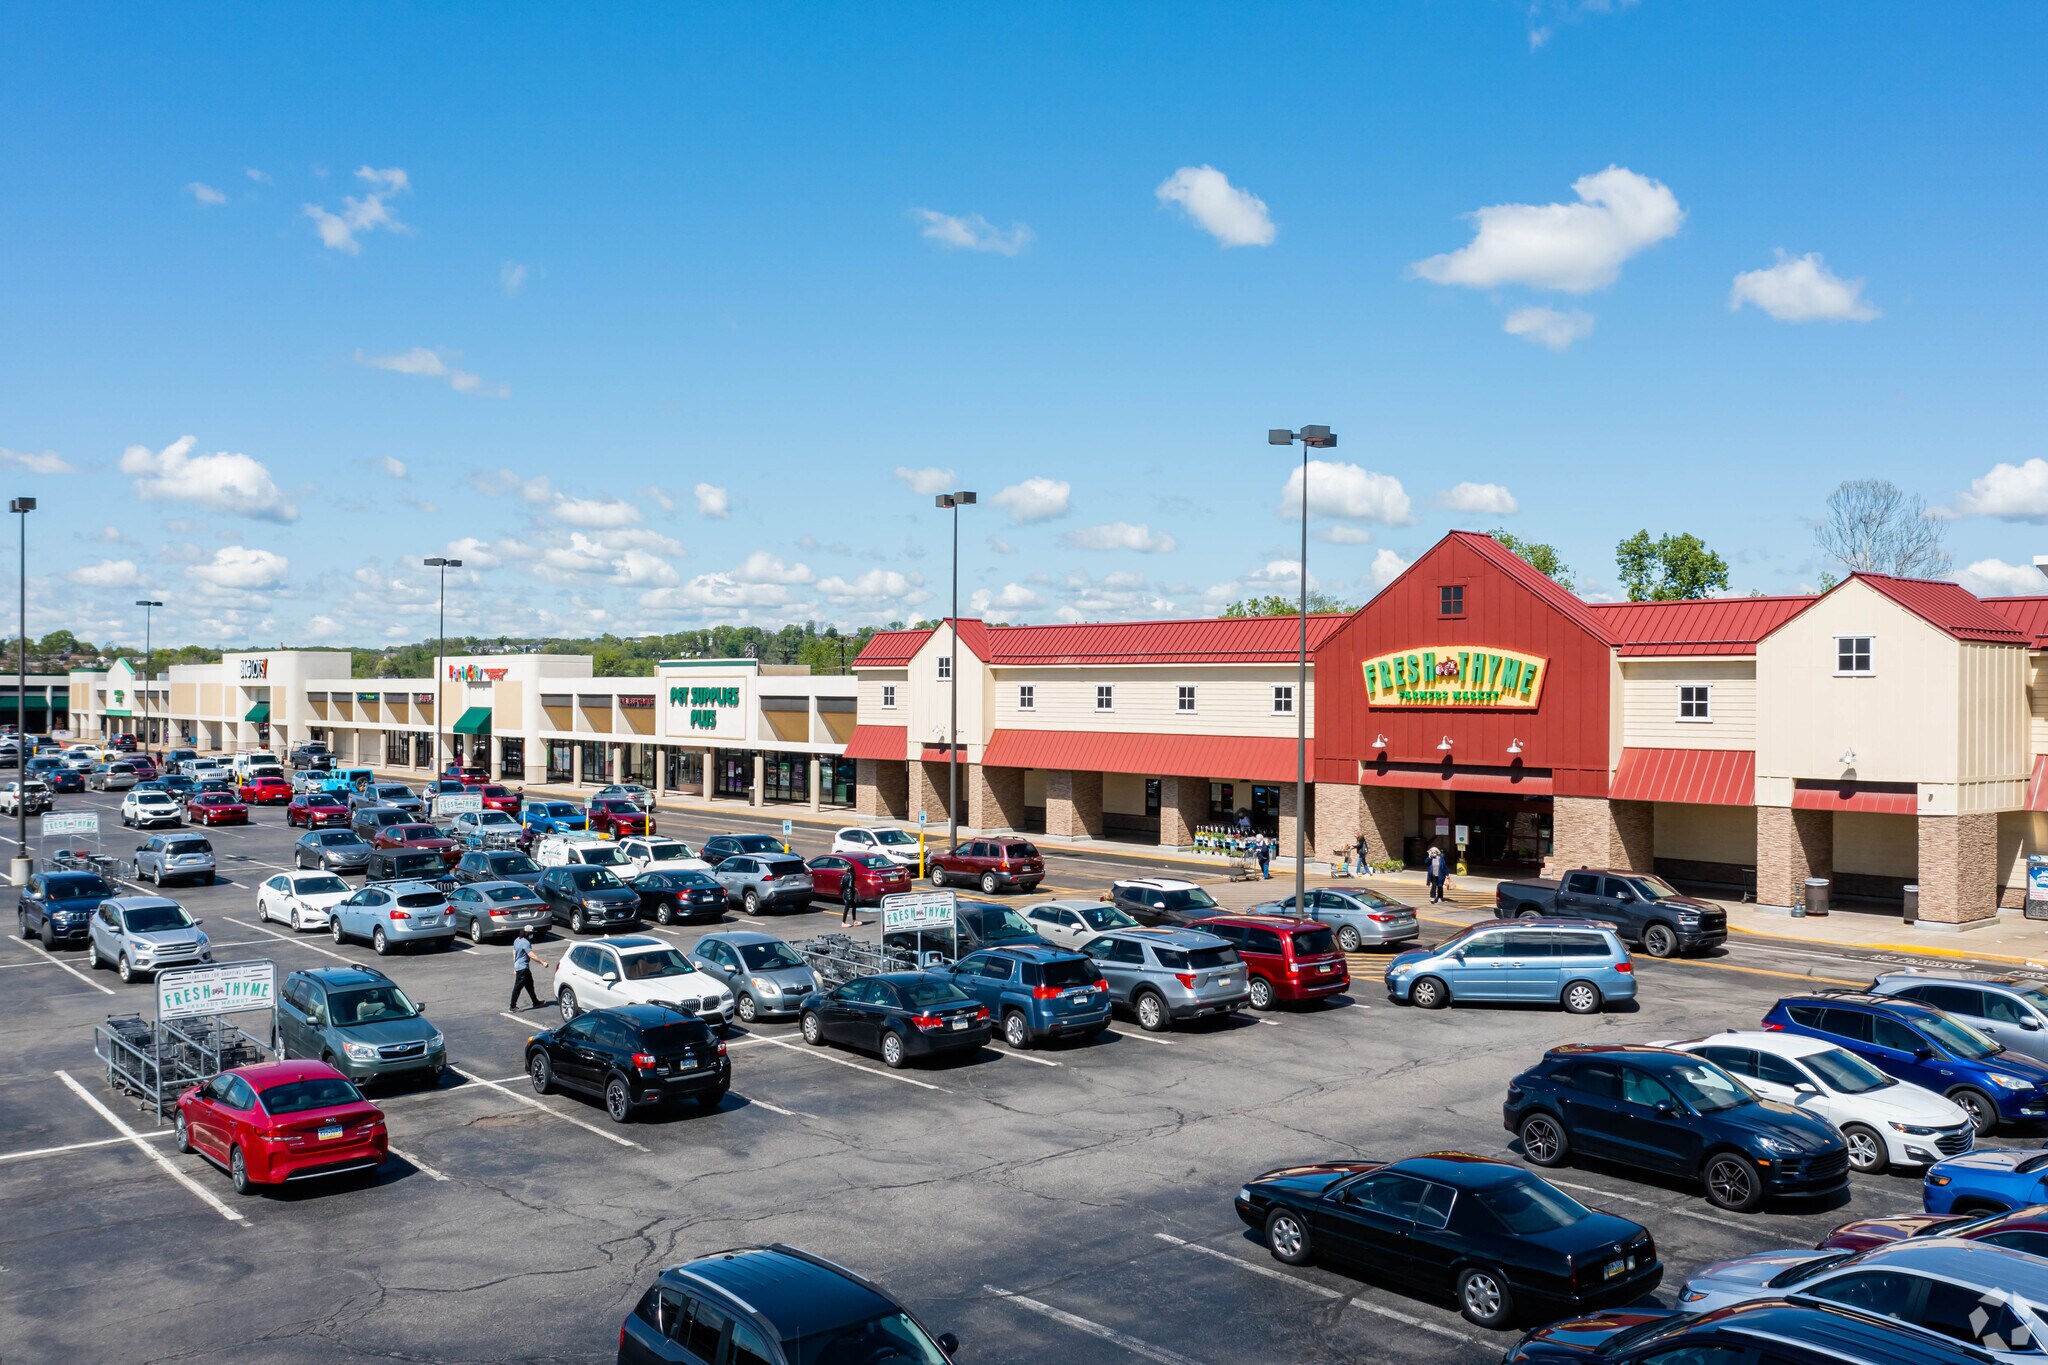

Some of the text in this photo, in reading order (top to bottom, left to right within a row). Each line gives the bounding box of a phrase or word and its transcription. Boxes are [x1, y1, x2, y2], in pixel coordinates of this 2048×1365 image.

[240, 659, 252, 679] BIG
[1364, 651, 1537, 695] FRESH THYME
[670, 687, 690, 705] PET
[691, 687, 740, 707] SUPPLIES
[1398, 690, 1500, 701] FARMERS MARKET
[690, 709, 717, 728] PLUS
[887, 906, 952, 925] FRESH THYME
[165, 982, 270, 1009] FRESH THYME
[186, 998, 249, 1010] FARMERS MARKET
